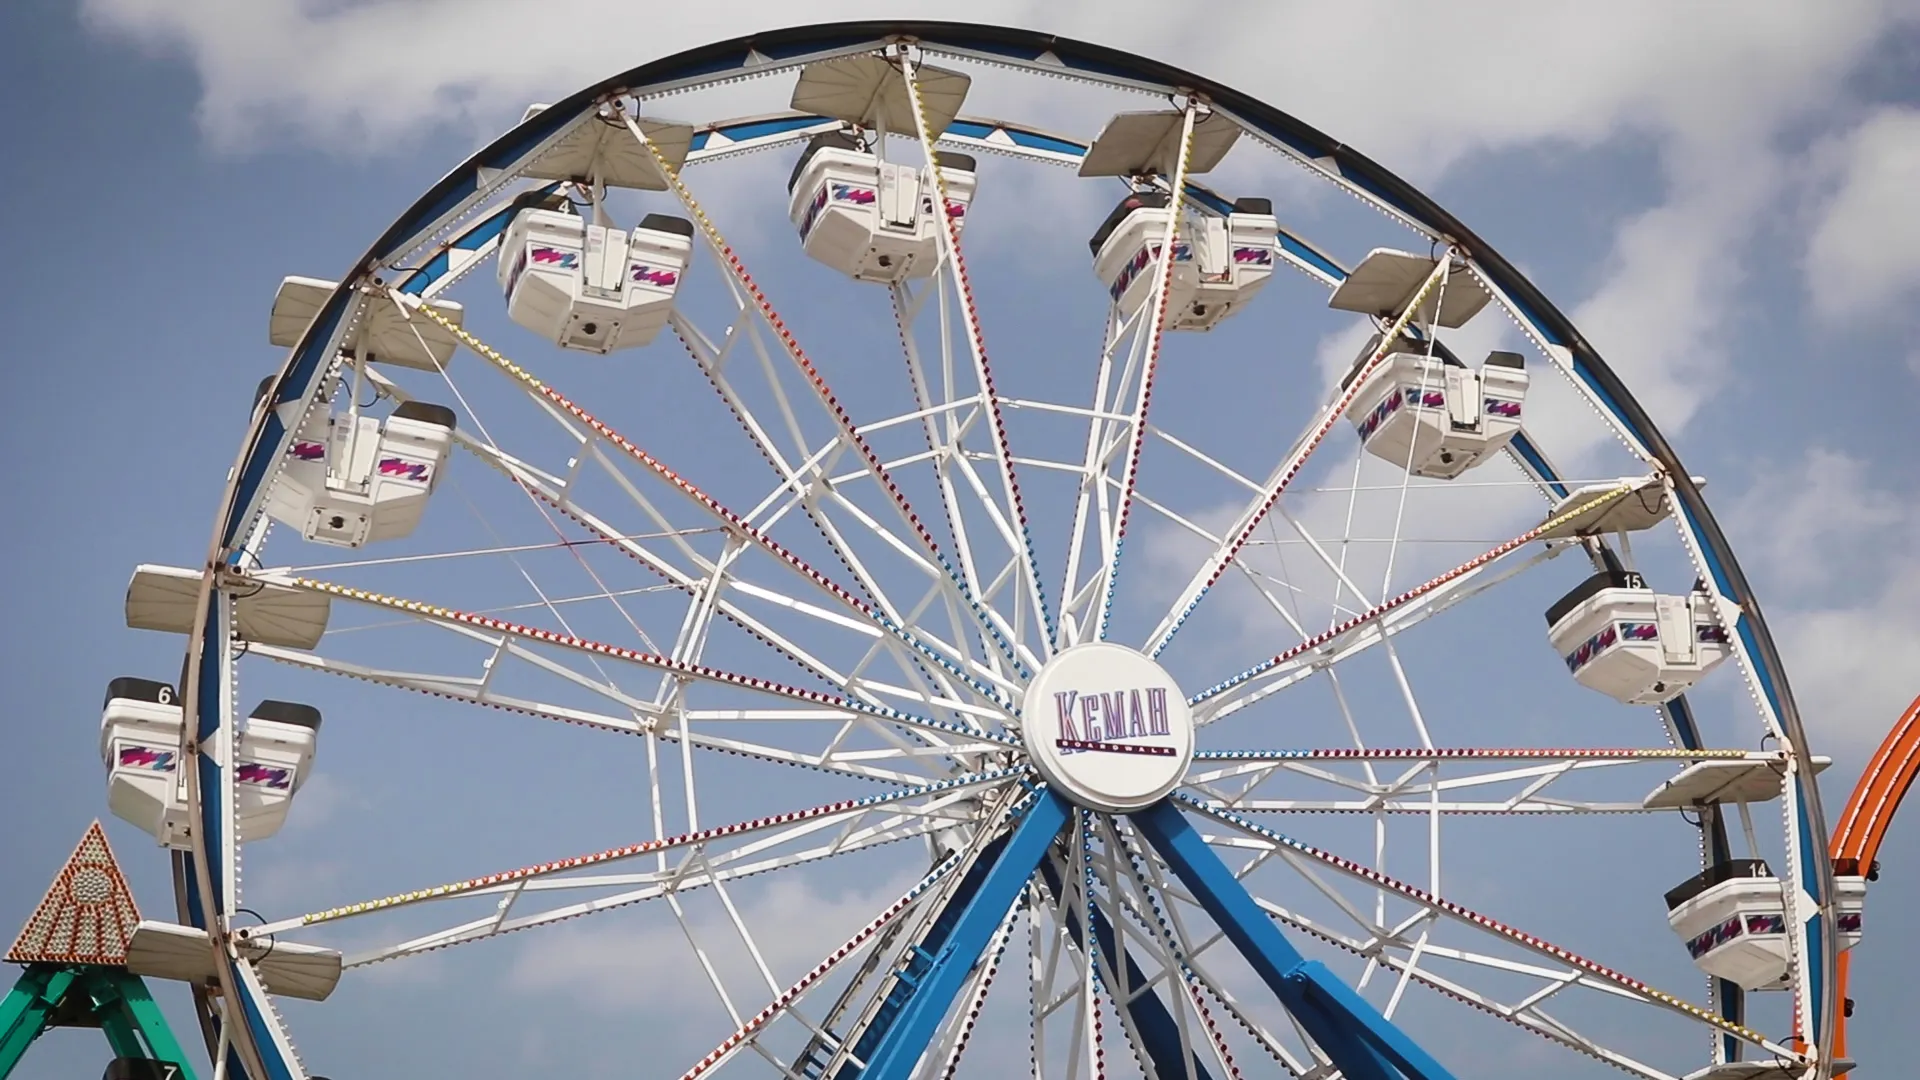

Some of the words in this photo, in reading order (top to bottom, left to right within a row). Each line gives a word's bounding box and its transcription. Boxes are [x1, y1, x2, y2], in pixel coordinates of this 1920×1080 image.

[855, 138, 866, 153] 3
[558, 199, 570, 215] 4
[1624, 574, 1641, 590] 15
[158, 686, 171, 704] 6
[1054, 688, 1170, 755] KEMAH
[1062, 741, 1170, 754] BOARDWALK
[1749, 862, 1767, 878] 14
[164, 1065, 177, 1080] 7
